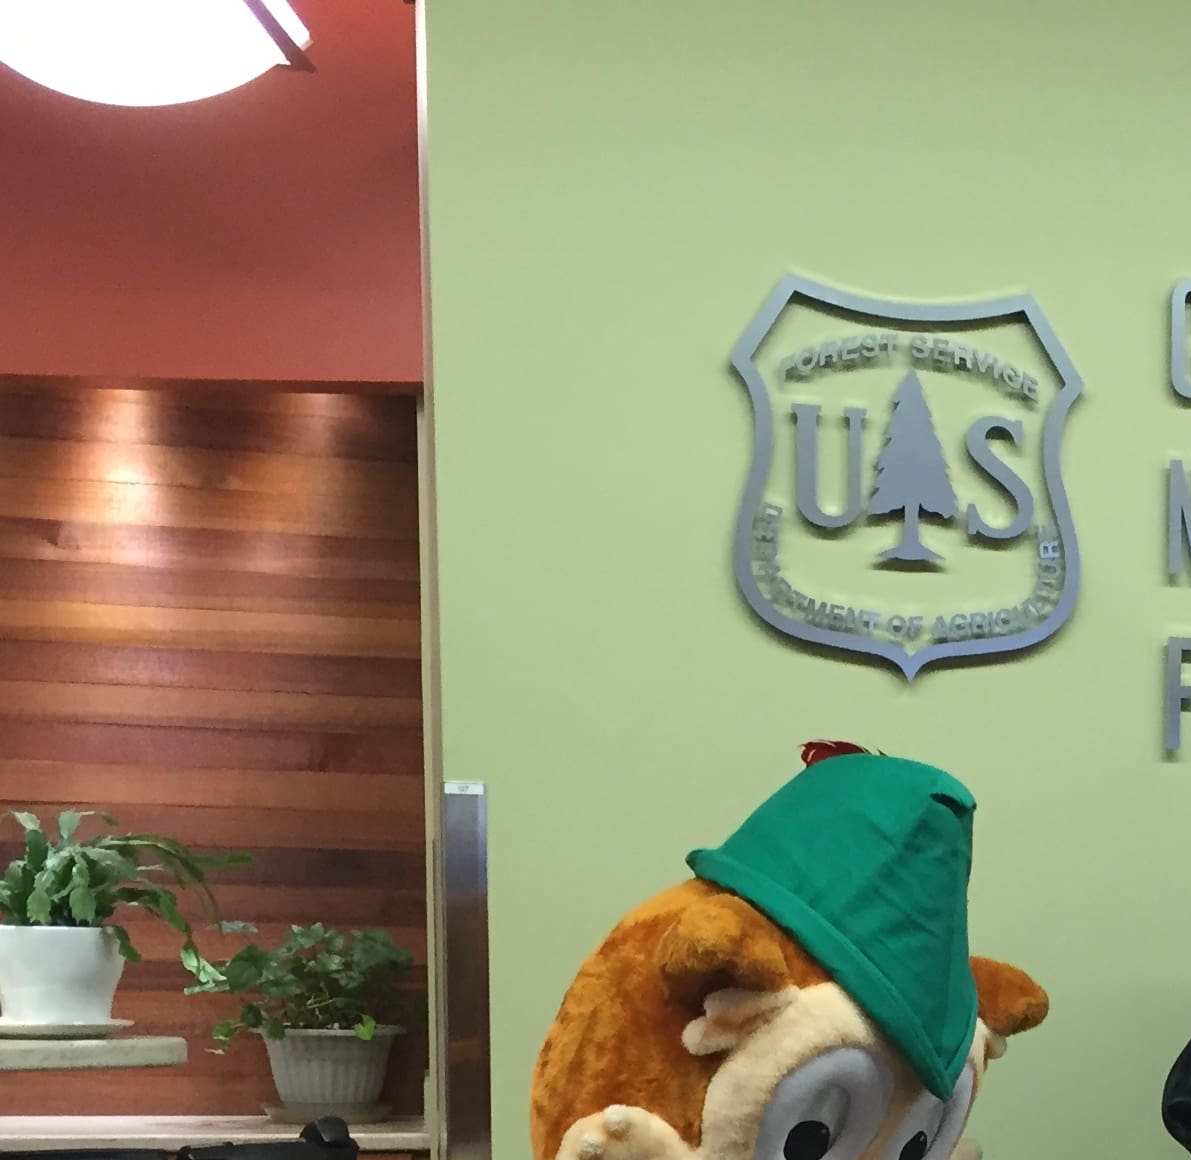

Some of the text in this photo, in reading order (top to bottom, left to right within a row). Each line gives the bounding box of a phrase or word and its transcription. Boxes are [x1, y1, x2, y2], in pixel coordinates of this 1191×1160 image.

[782, 333, 1040, 401] FOREST SERVICE
[887, 614, 924, 640] OF
